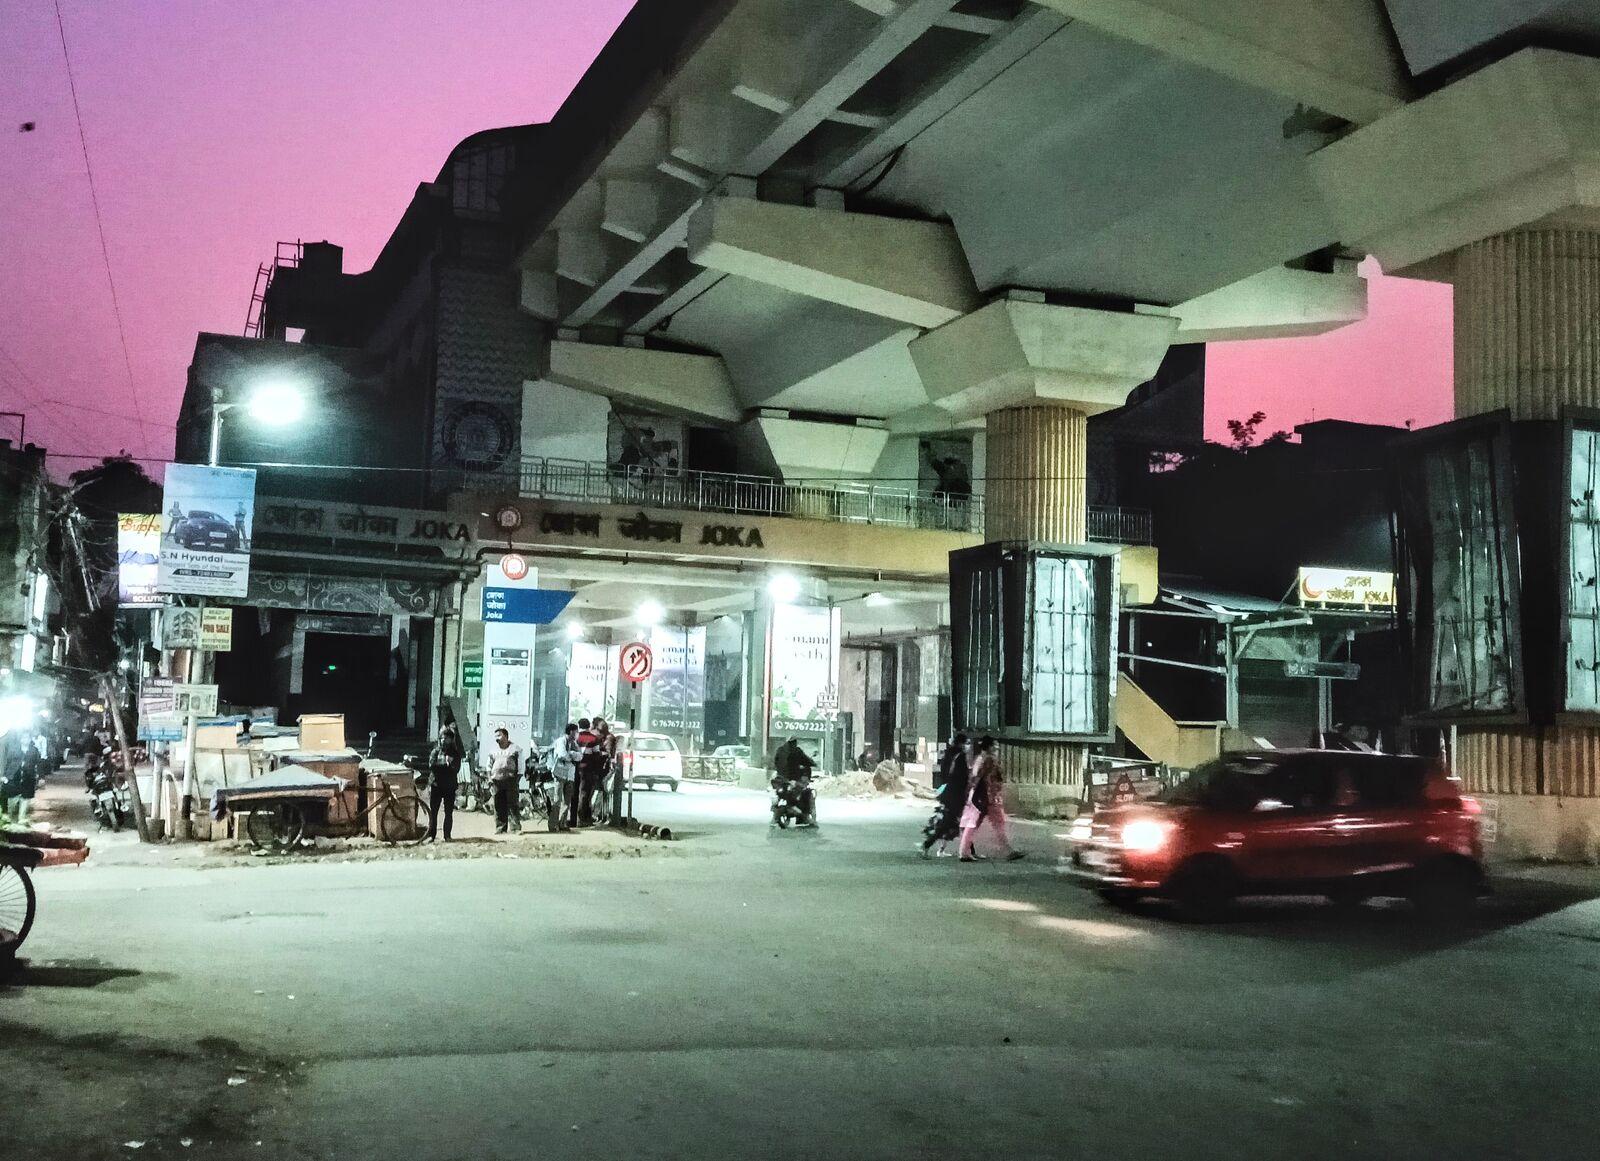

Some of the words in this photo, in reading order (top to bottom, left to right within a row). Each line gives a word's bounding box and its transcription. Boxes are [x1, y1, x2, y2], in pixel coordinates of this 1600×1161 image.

[410, 519, 471, 542] JOKA
[700, 523, 765, 549] JOKA
[182, 552, 223, 564] Hyundai
[1363, 590, 1389, 602] JOKA
[486, 600, 507, 610] जोका
[202, 624, 214, 632] FOR
[216, 624, 229, 633] SALE
[784, 721, 834, 732] 767672222
[1120, 783, 1128, 792] GO
